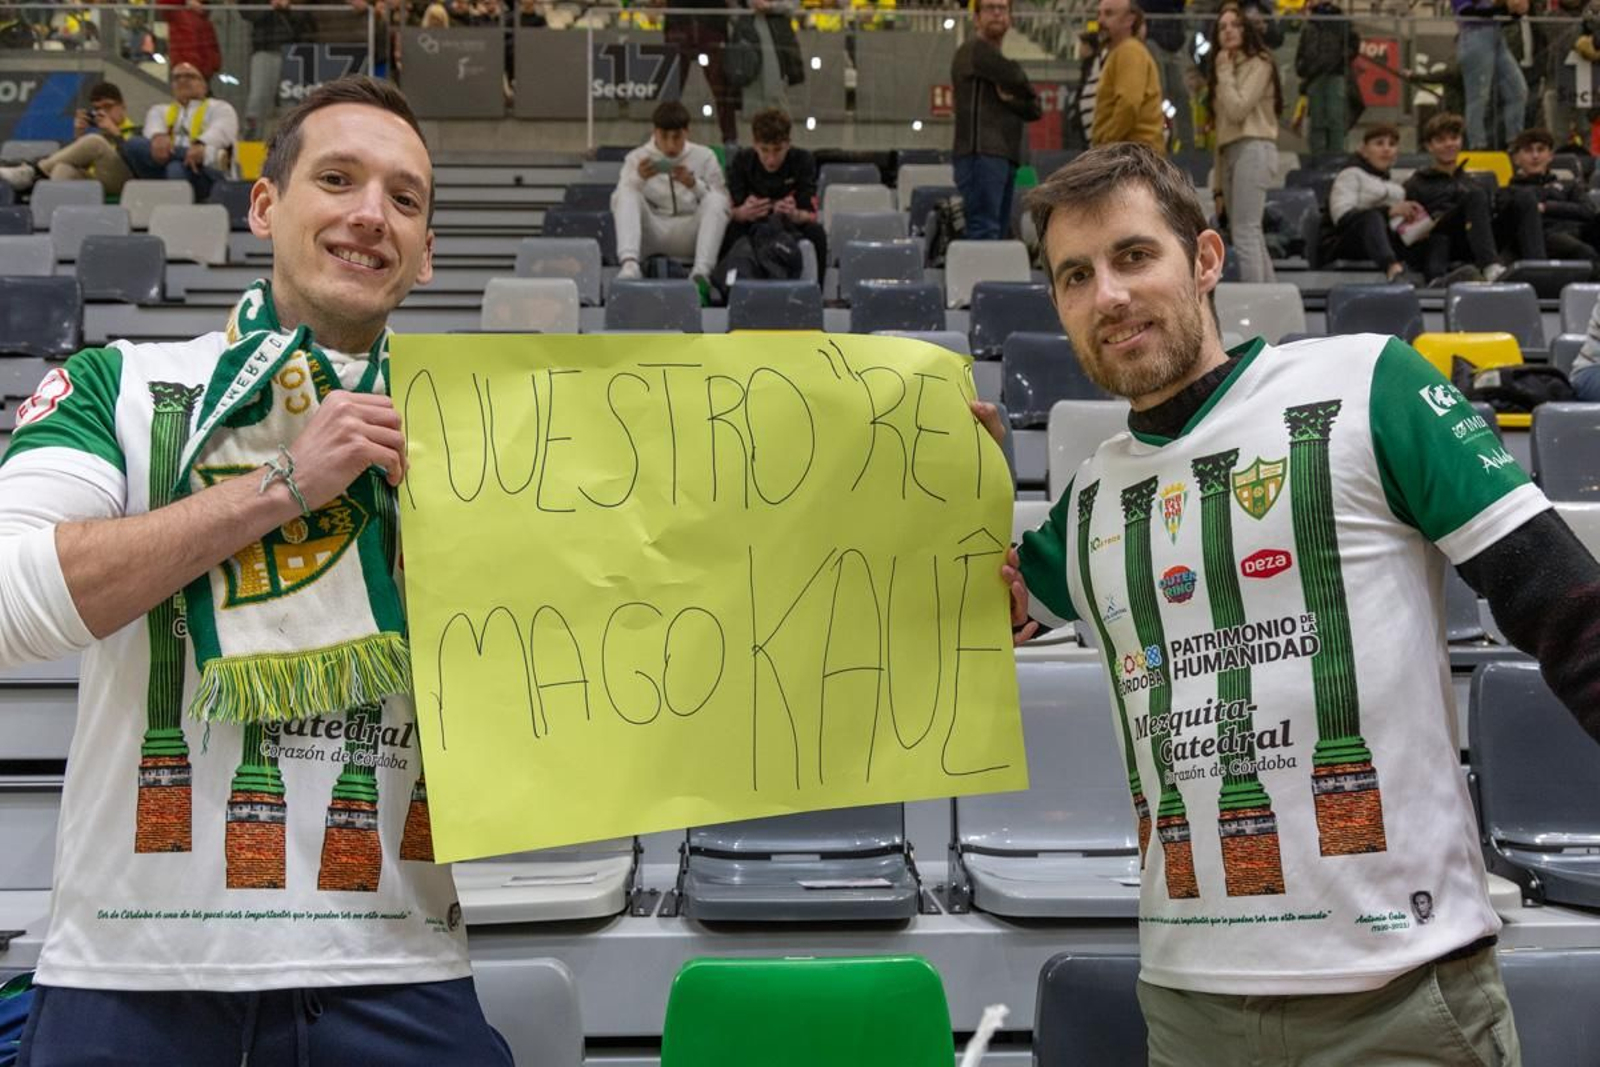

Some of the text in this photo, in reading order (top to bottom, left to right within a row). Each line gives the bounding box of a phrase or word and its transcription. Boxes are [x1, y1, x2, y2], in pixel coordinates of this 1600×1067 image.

[287, 43, 368, 86] 17
[598, 42, 684, 99] 17
[592, 78, 658, 98] Sector
[403, 363, 816, 512] NUESTRO
[1171, 614, 1315, 659] PATRIMONIO DE
[1302, 623, 1316, 634] LA
[430, 527, 1011, 791] MAGO KAUÊ
[1173, 635, 1320, 681] HUMANIDAD
[1135, 697, 1258, 741] Mezquita-
[261, 740, 408, 770] Corazón de Córdoba
[1160, 719, 1294, 765] Catedral
[1209, 762, 1226, 776] de
[1229, 754, 1297, 774] Córdoba
